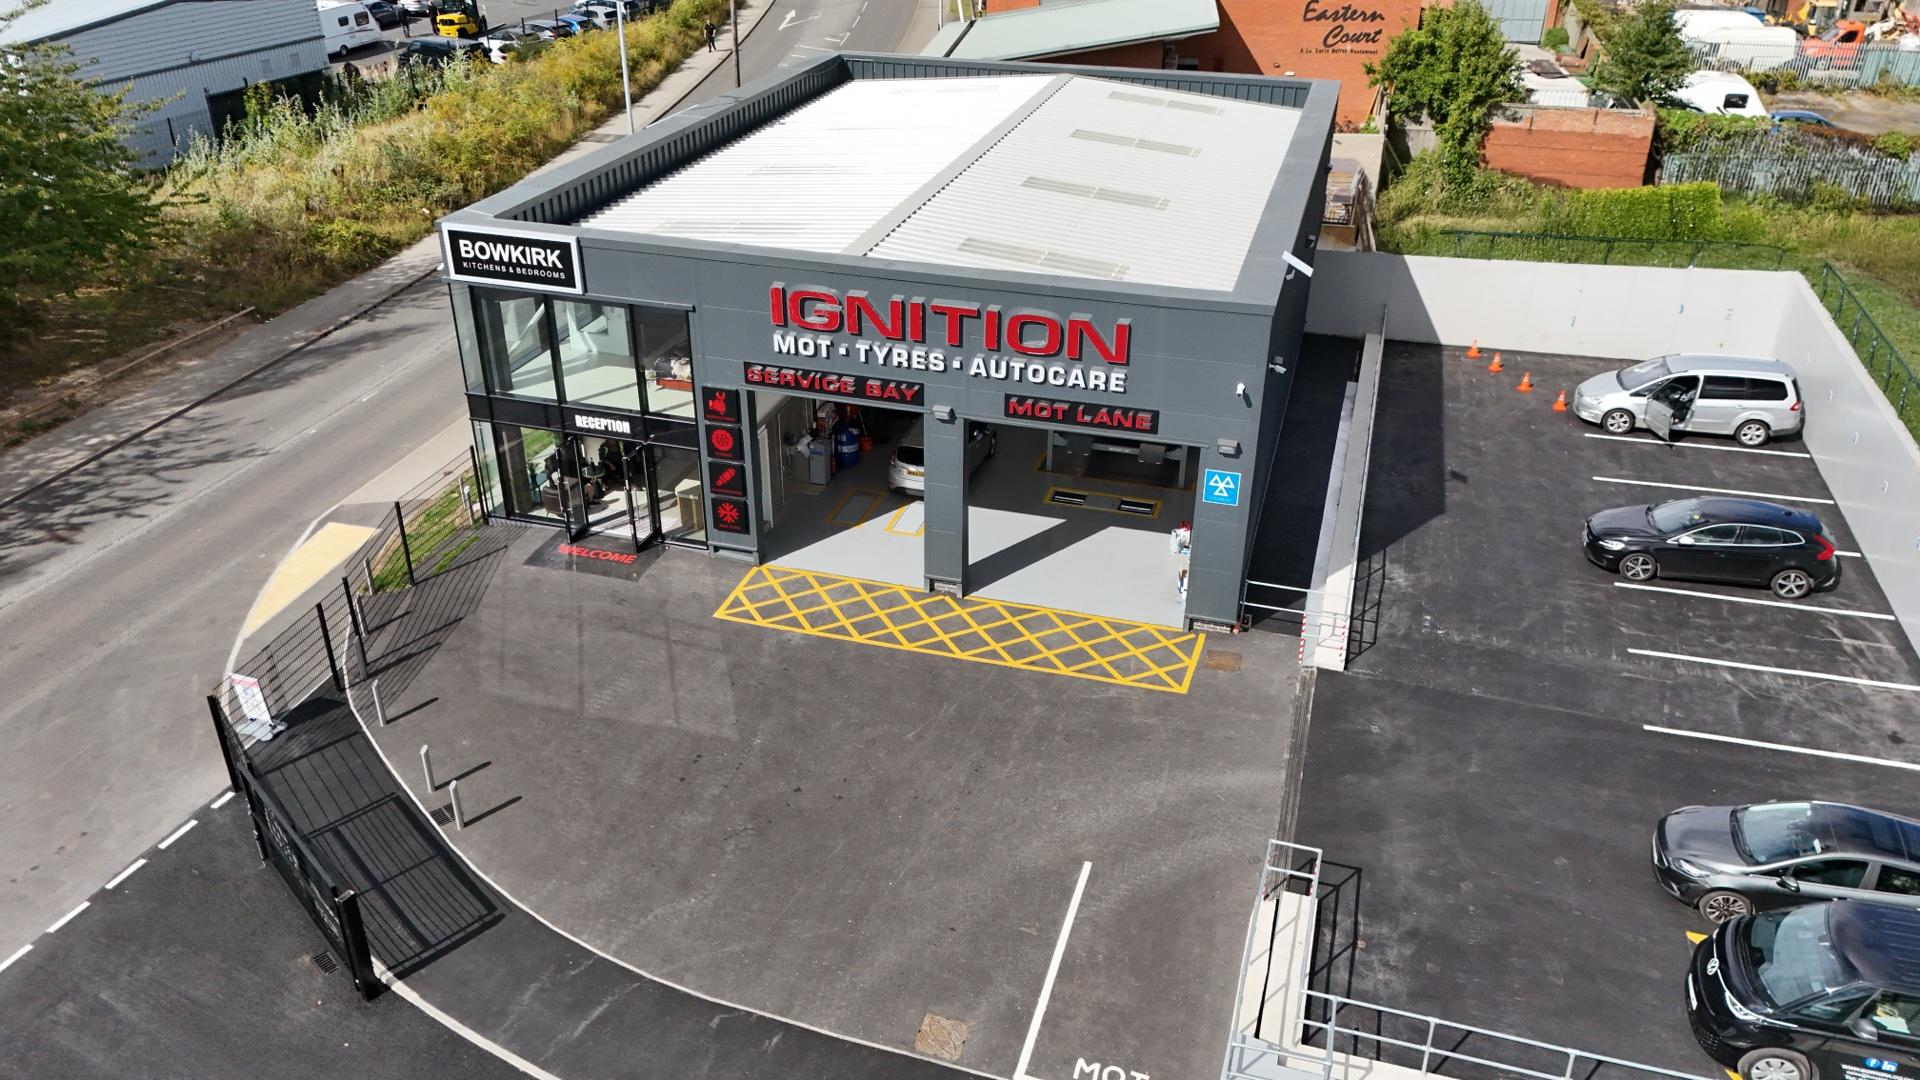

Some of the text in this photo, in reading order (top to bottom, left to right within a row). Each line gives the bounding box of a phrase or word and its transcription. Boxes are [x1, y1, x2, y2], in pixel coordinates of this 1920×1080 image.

[1302, 0, 1385, 22] Eastern
[1323, 24, 1383, 48] Court
[458, 239, 564, 269] BOWKIRK
[463, 261, 507, 273] KITCHENS
[516, 267, 566, 280] BEDROOMS
[769, 282, 1131, 364] IGNITION
[772, 331, 1128, 394] MOT TYRES AUTOCARE
[747, 365, 920, 401] SERVICE BAY
[574, 414, 631, 434] RECEPTION
[1008, 397, 1153, 432] MOT LANE
[557, 543, 638, 565] WELCOME
